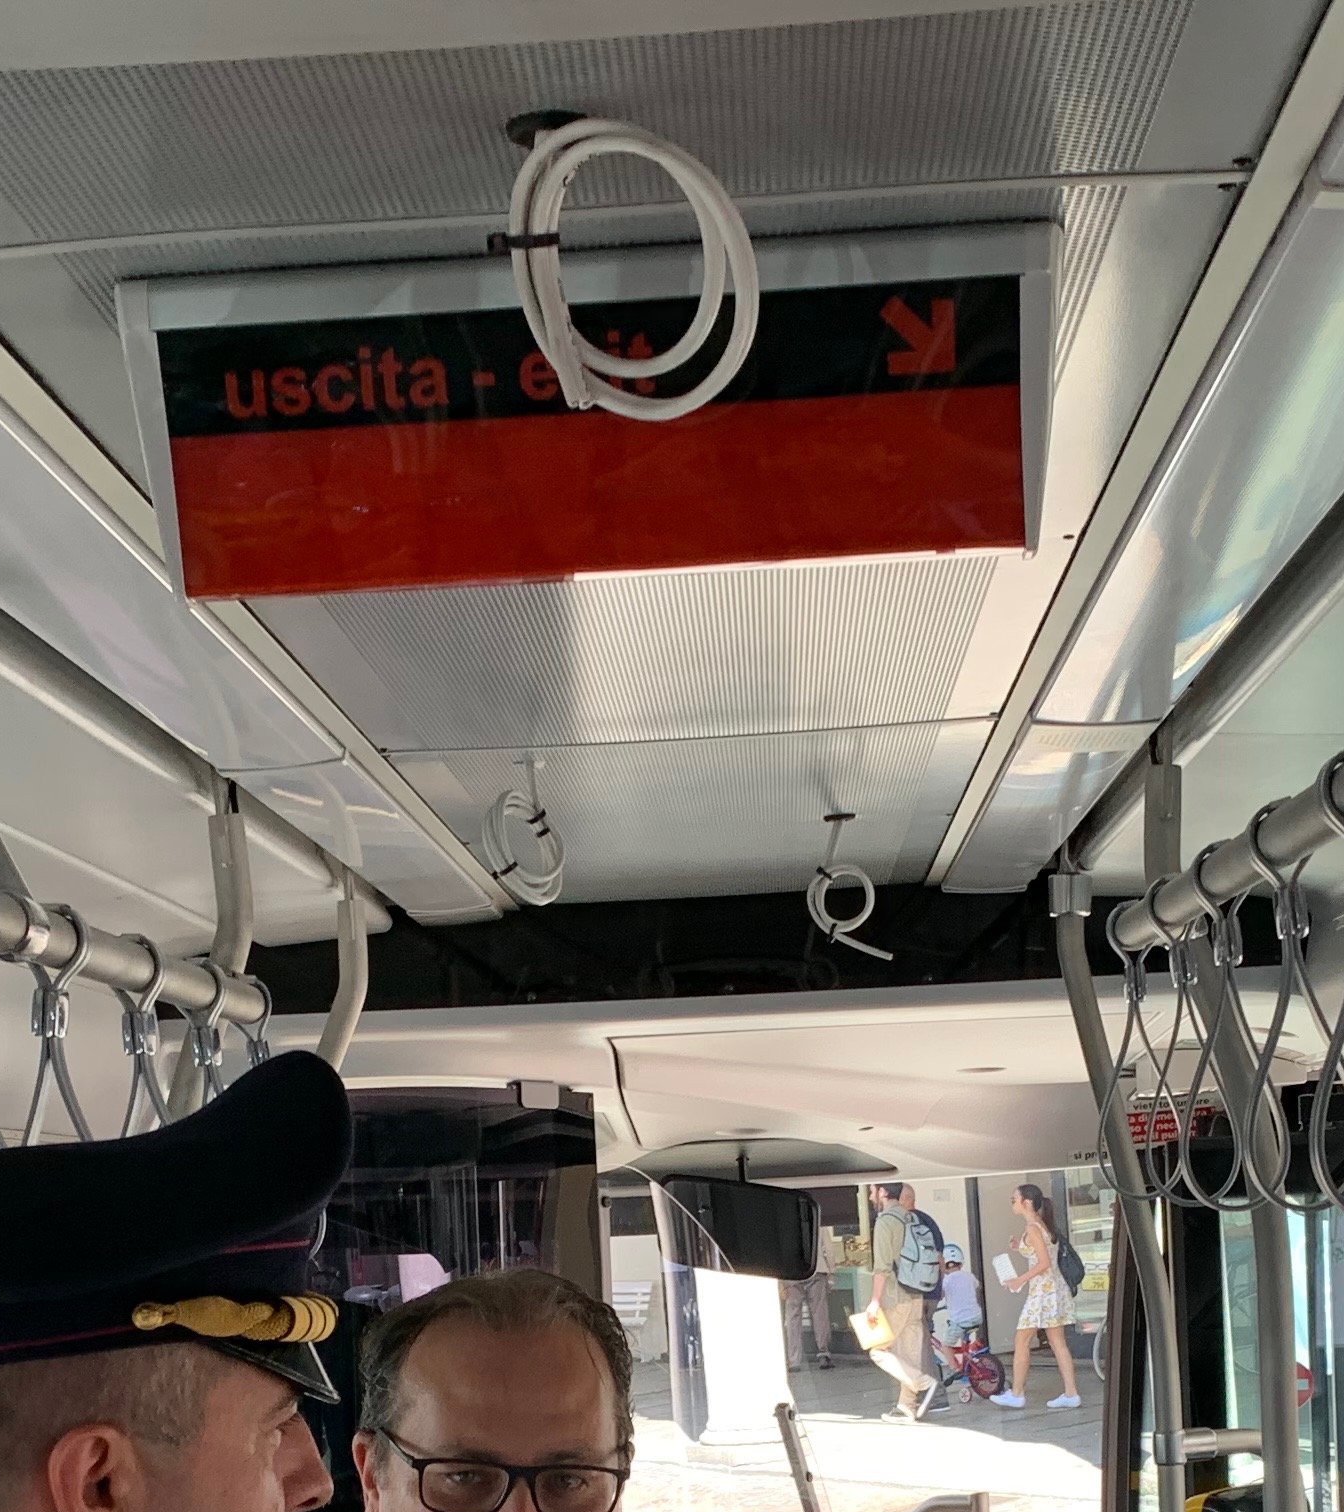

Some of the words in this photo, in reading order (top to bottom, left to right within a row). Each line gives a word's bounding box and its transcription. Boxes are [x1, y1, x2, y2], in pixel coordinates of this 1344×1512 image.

[224, 344, 451, 420] uscita
[518, 328, 656, 402] eit
[1132, 1101, 1170, 1111] vietto
